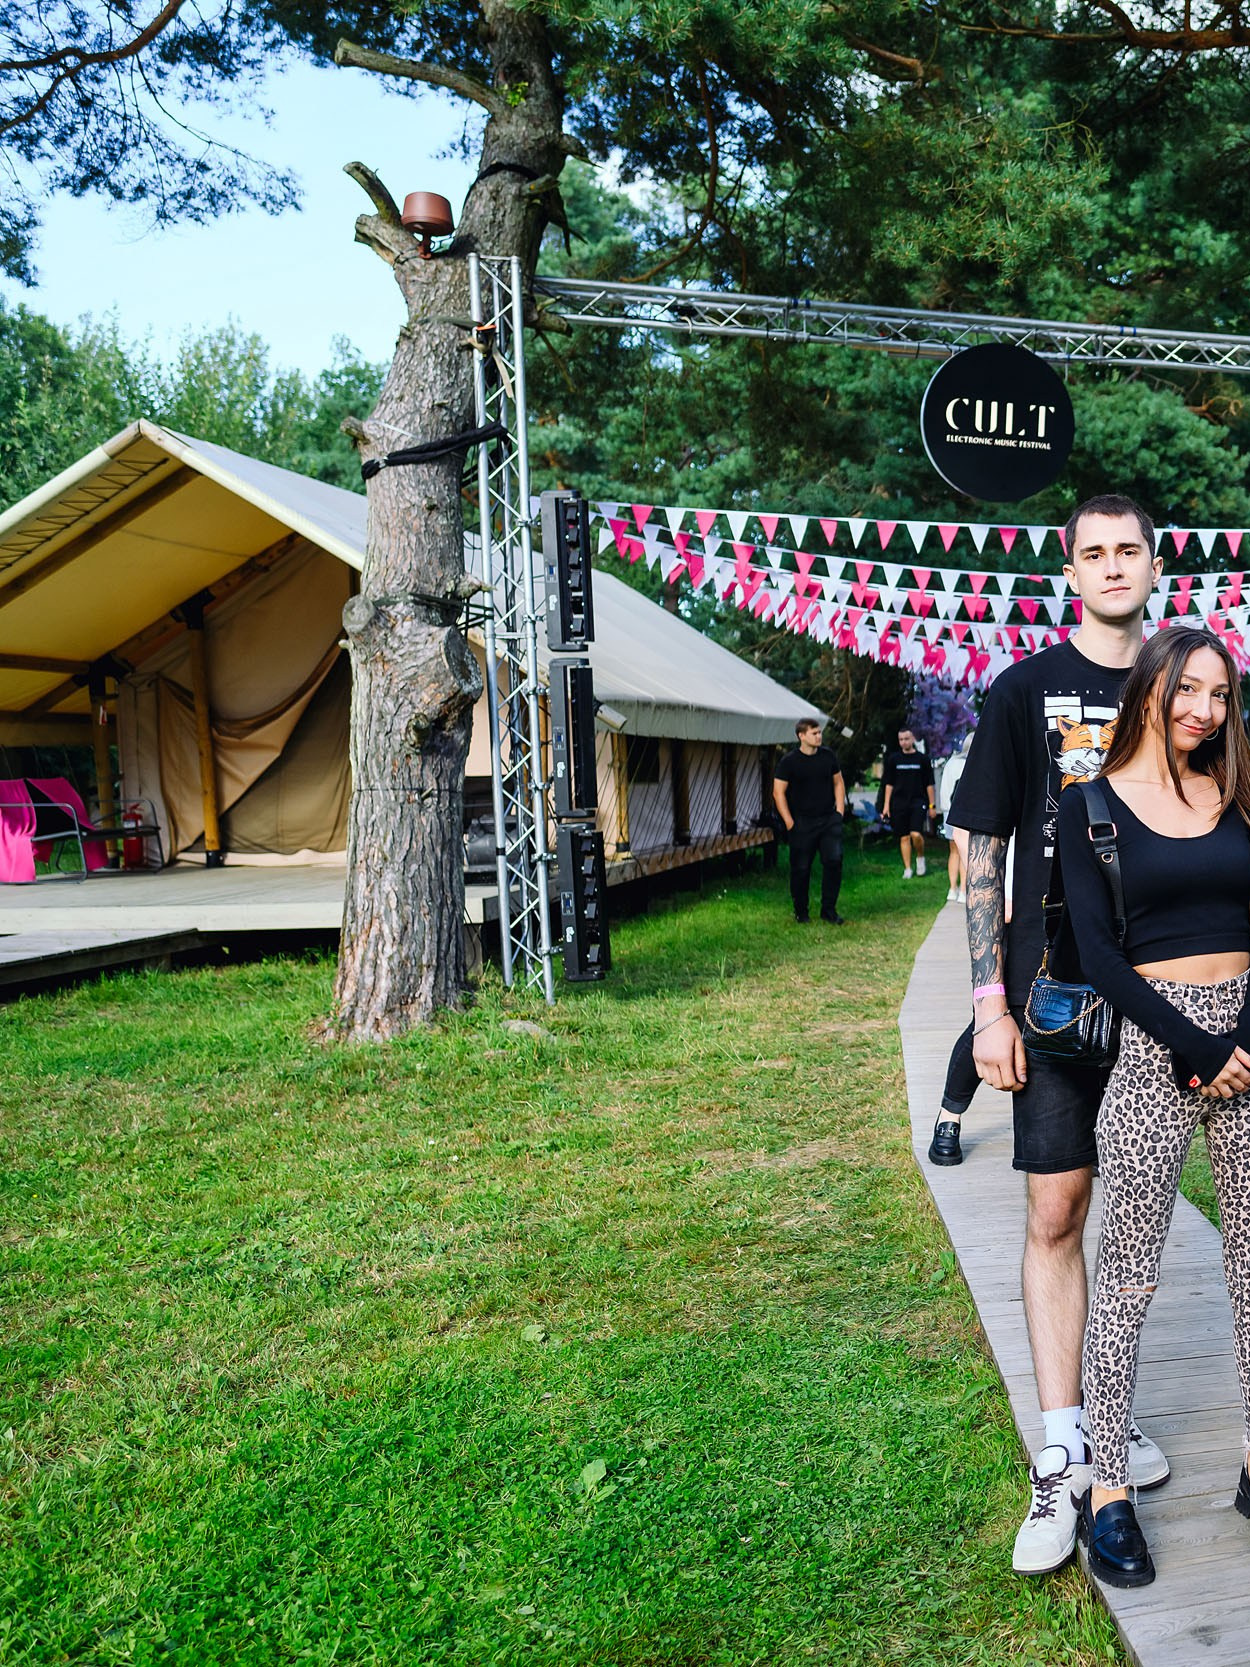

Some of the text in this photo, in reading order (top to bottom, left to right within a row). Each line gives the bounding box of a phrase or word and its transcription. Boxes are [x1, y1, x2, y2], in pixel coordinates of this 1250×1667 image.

[945, 398, 1055, 438] CULT
[946, 434, 1052, 450] ELECTRONIC MUSIC FESTIVAL
